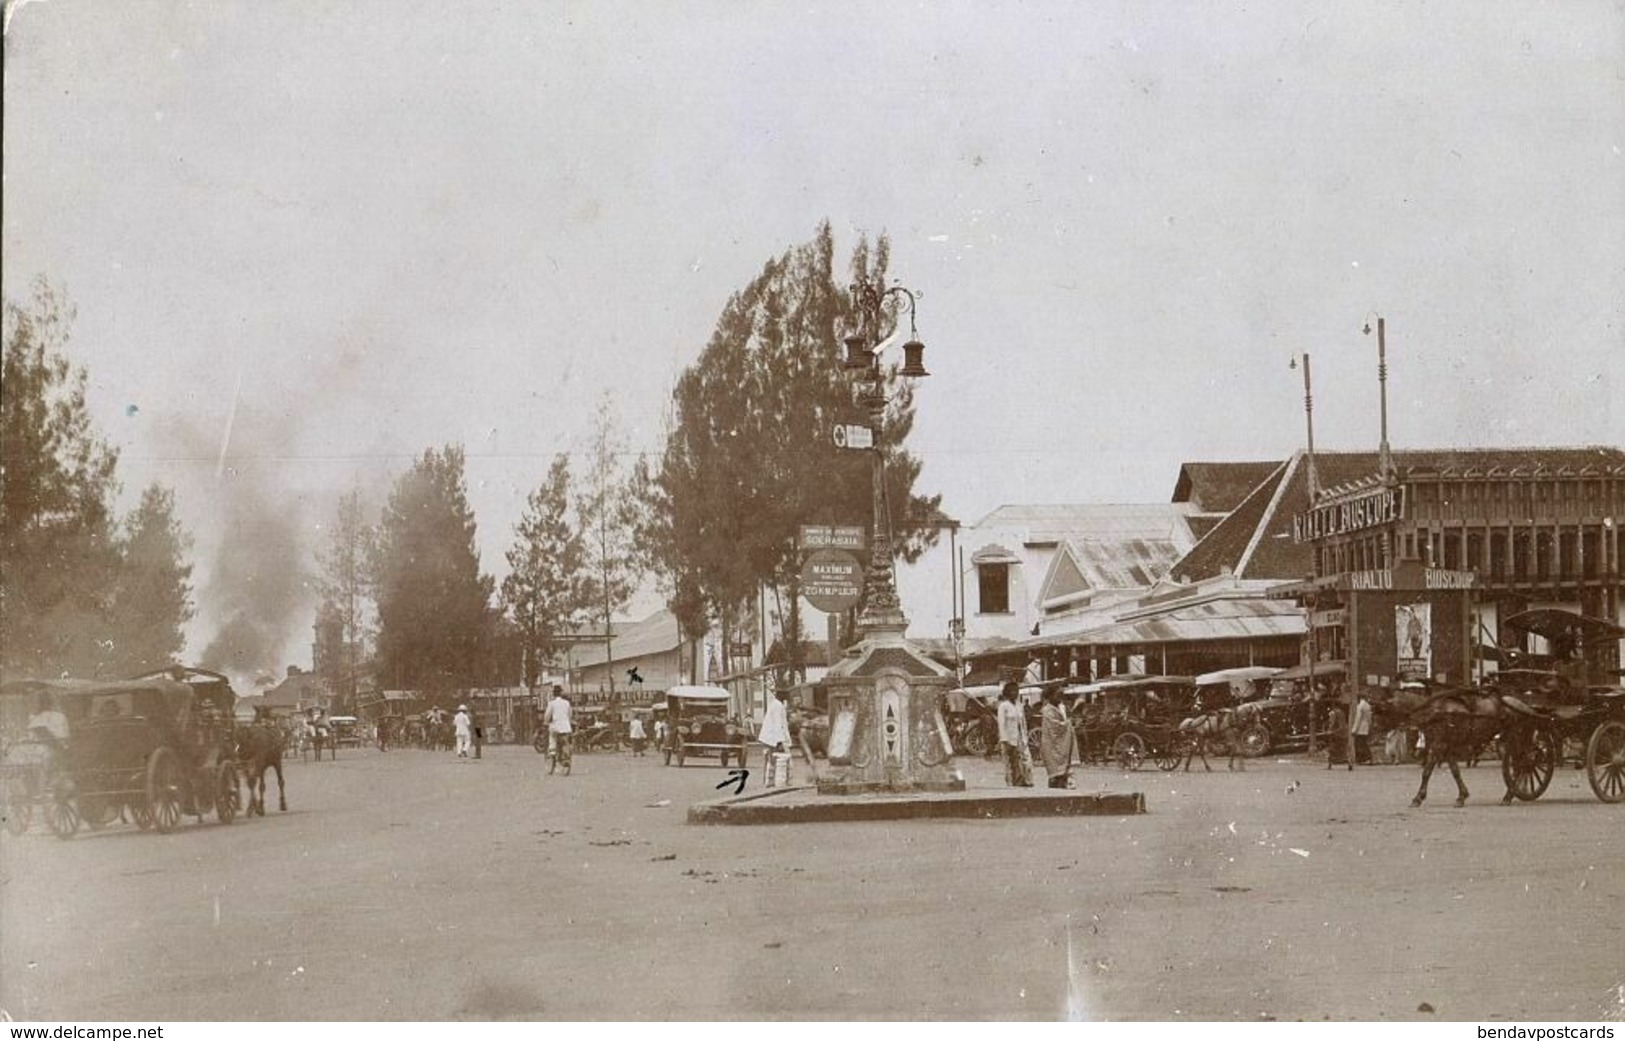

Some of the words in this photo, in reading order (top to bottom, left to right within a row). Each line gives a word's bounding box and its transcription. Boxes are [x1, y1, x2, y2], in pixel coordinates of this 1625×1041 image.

[813, 564, 852, 575] MAXIMUM
[1351, 569, 1392, 589] RIALTO
[1425, 568, 1475, 589] BIOSCOOP
